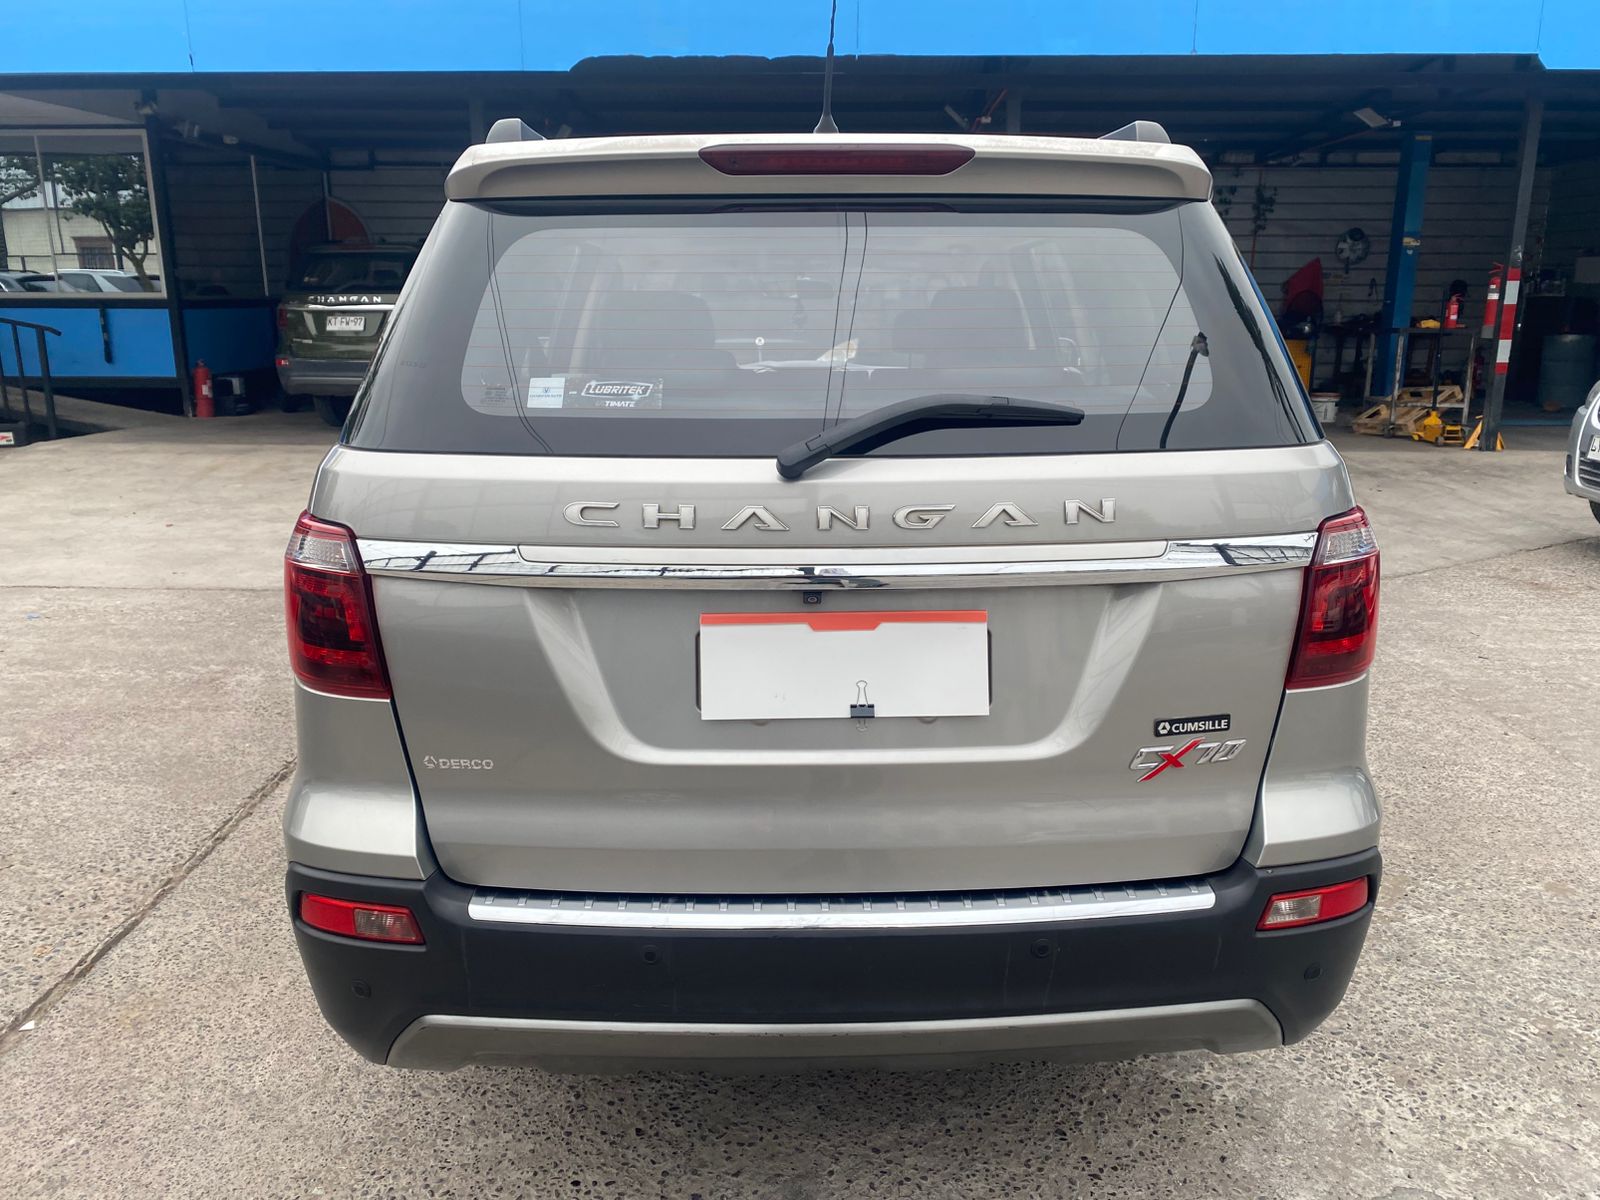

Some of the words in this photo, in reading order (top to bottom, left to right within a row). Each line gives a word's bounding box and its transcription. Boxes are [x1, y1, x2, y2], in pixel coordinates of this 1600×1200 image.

[589, 385, 646, 395] LUBRITEK
[563, 497, 1117, 531] CHANGAN
[1171, 719, 1228, 733] CUMSILLE
[439, 758, 494, 770] DERCO
